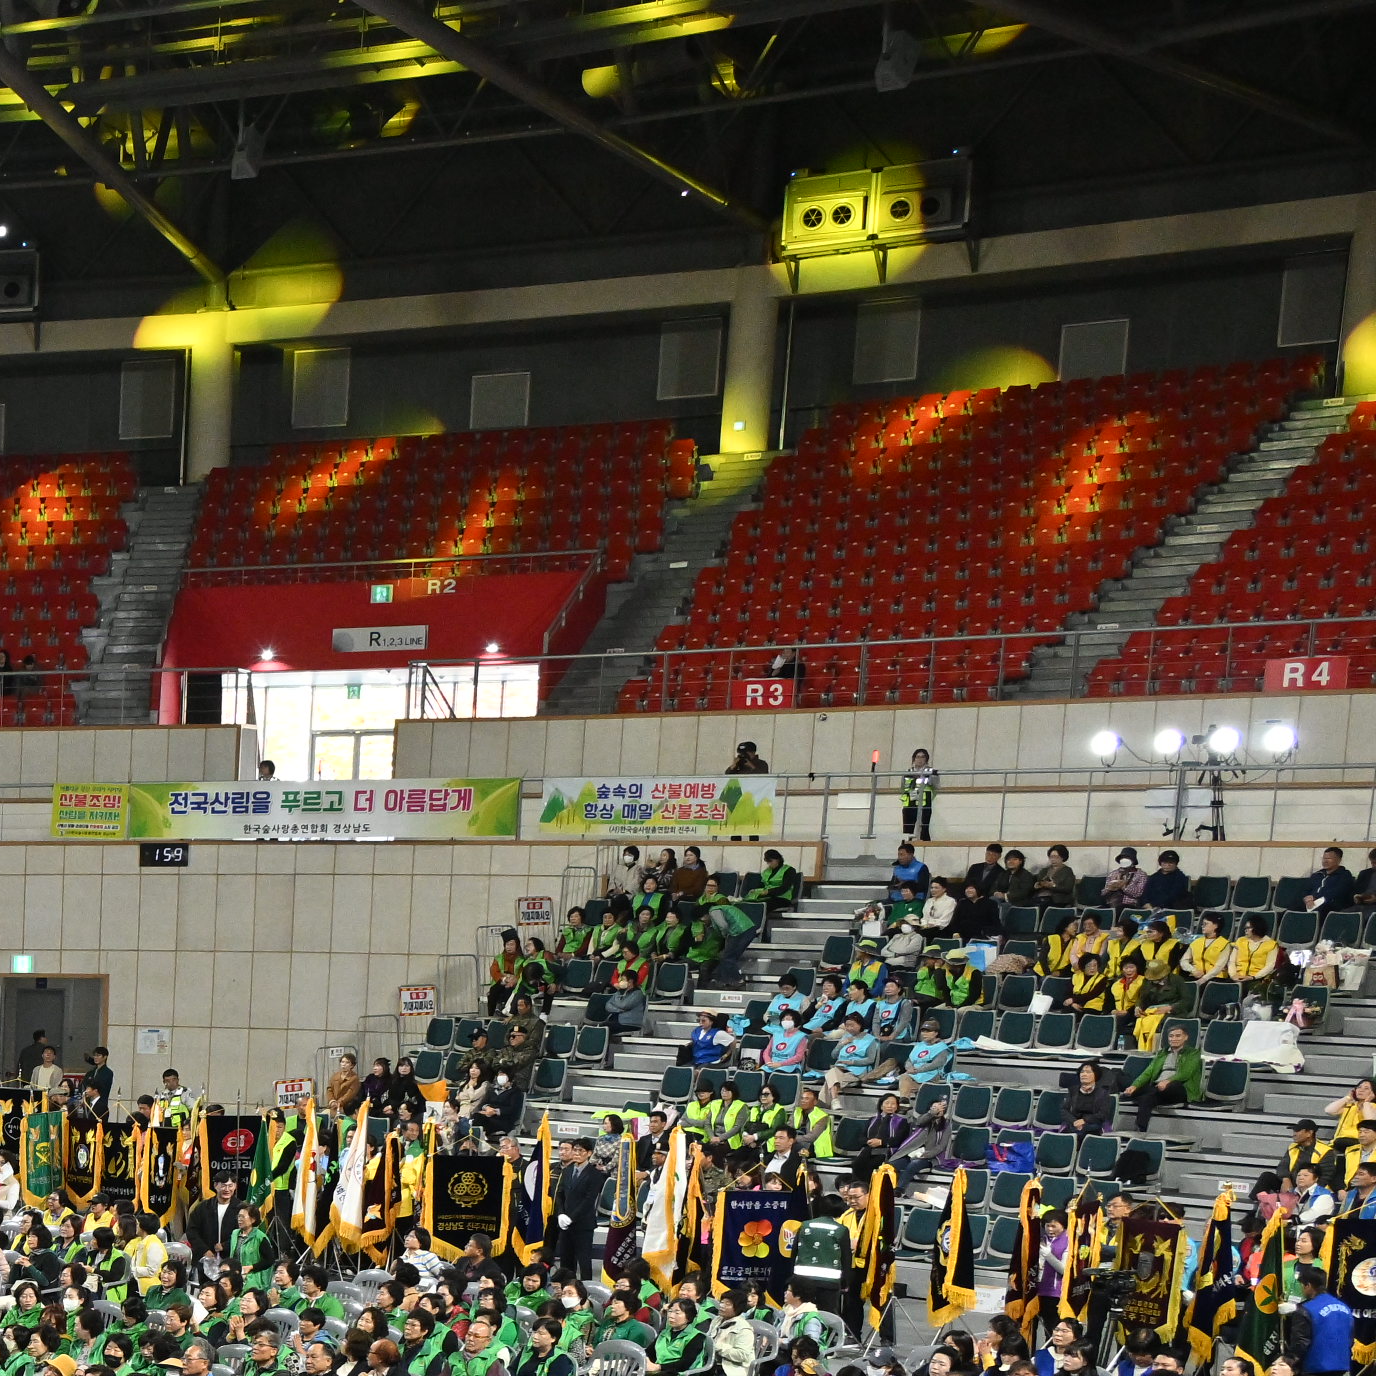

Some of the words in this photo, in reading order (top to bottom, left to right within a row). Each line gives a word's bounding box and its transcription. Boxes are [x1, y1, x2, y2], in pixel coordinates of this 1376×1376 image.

[427, 578, 456, 595] R2
[1282, 661, 1331, 688] R4
[745, 683, 784, 706] R3
[596, 783, 643, 800] 숲속의
[650, 782, 717, 800] 산불예방
[59, 793, 122, 808] 산불조심!
[168, 790, 271, 815] 전국산림을
[280, 789, 344, 814] 푸르고
[353, 789, 374, 813] 더
[384, 787, 473, 813] 아름답게
[583, 802, 615, 820] 항상
[621, 802, 653, 820] 매일
[660, 802, 726, 821] 산불조심
[243, 822, 328, 835] 한국숲사랑총연합회
[333, 822, 371, 834] 경상남도
[730, 1200, 761, 1210] 한사람을
[437, 1221, 464, 1231] 경상남도
